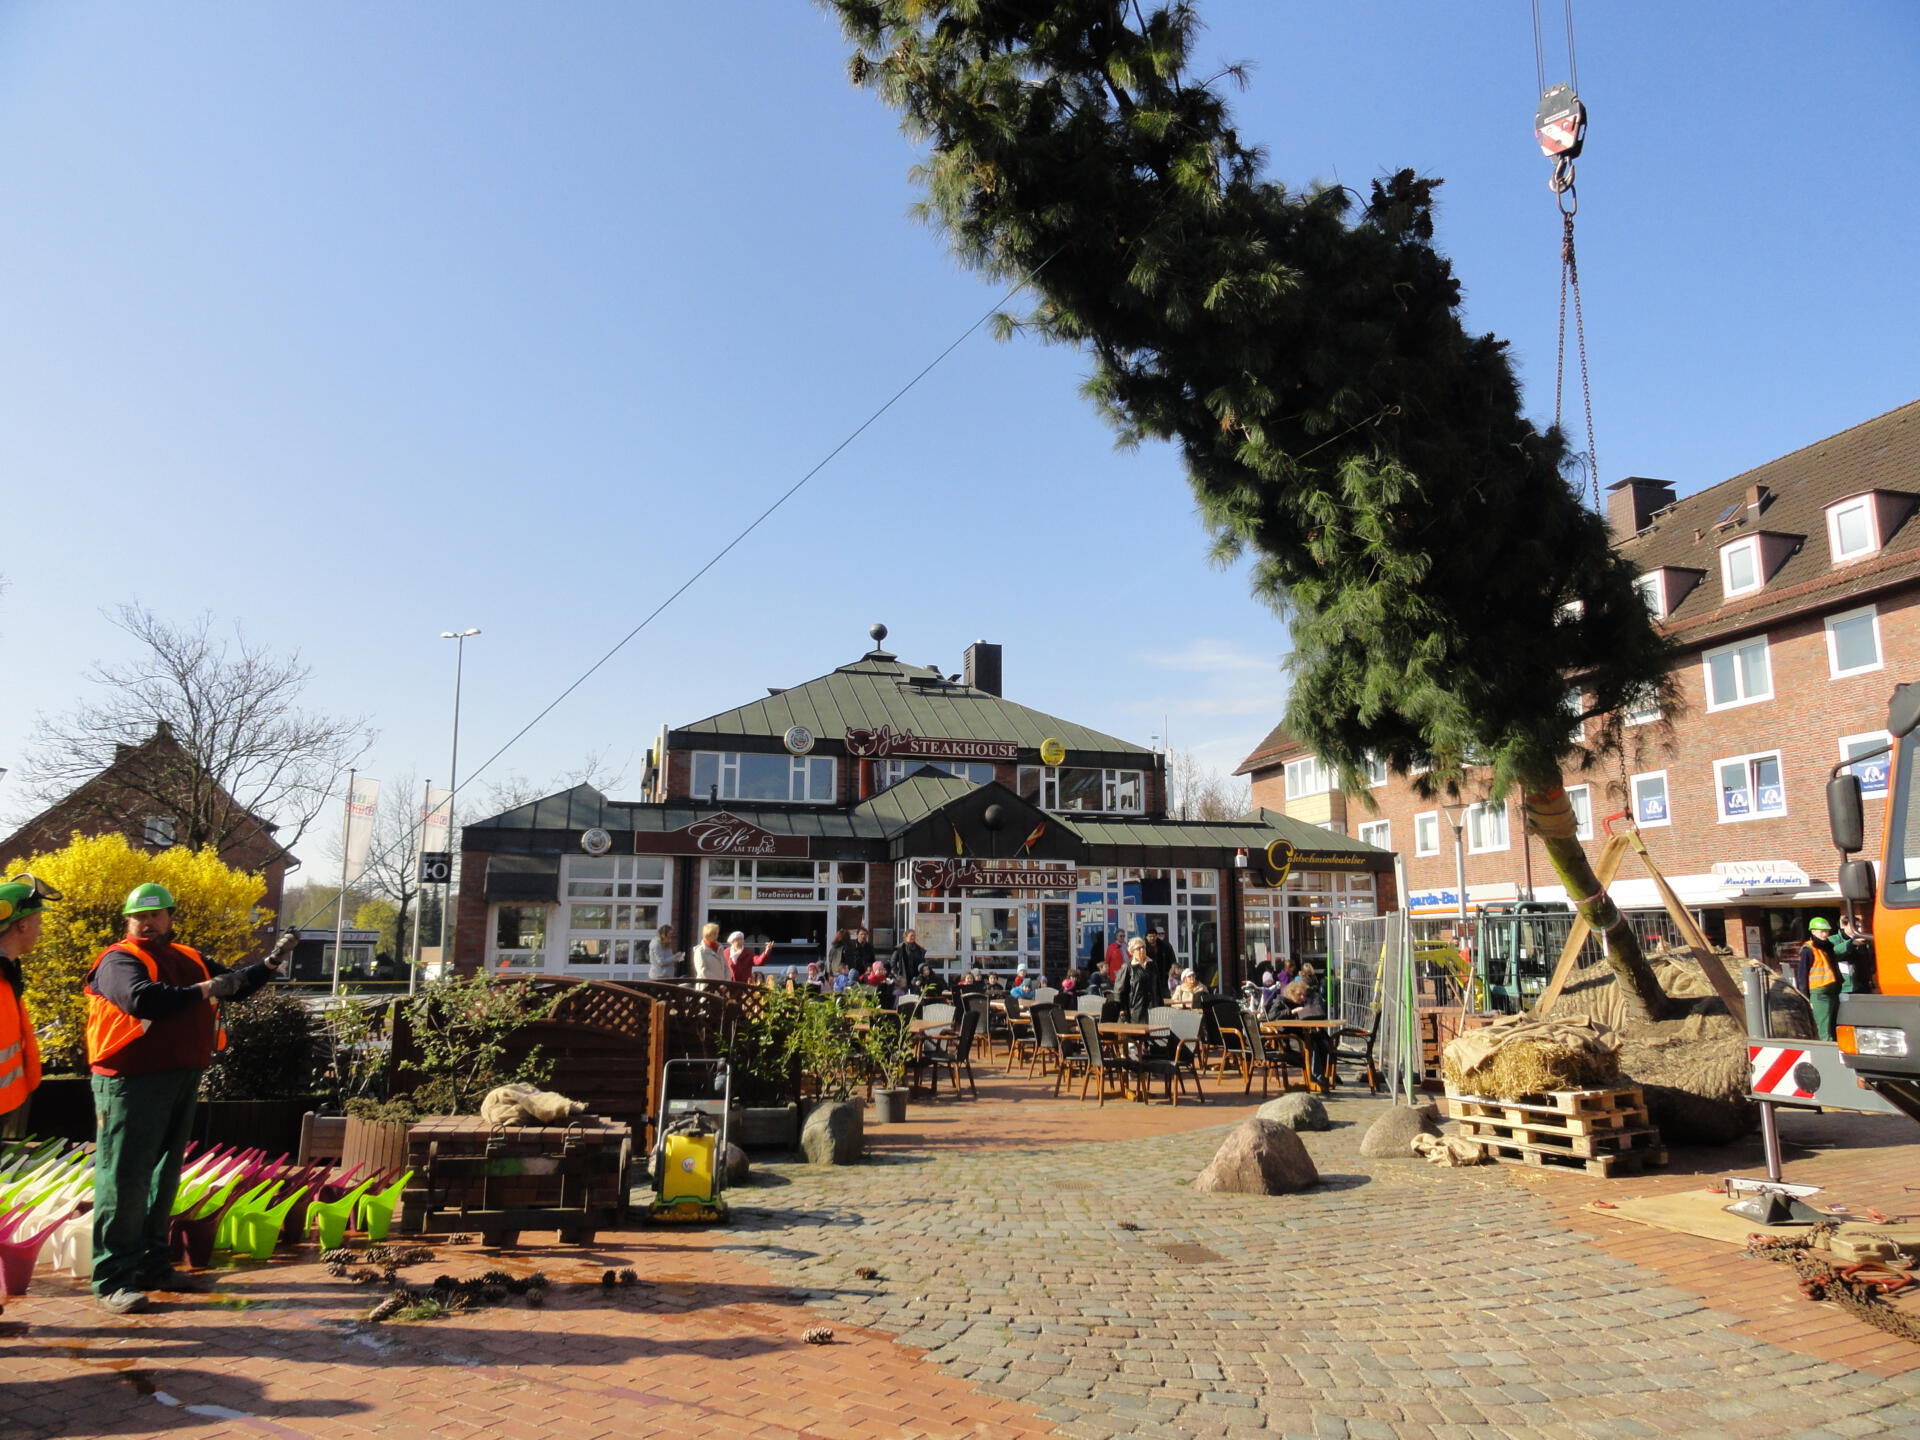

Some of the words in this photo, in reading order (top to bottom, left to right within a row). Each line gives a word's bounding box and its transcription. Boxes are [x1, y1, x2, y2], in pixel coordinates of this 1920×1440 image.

[879, 725, 915, 756] Jas
[910, 740, 1018, 758] STEAKHOUSE
[688, 822, 756, 854] Café
[945, 859, 979, 888] Jas
[974, 872, 1077, 886] STEAKHOUSE
[757, 891, 813, 899] Straßenverkauf
